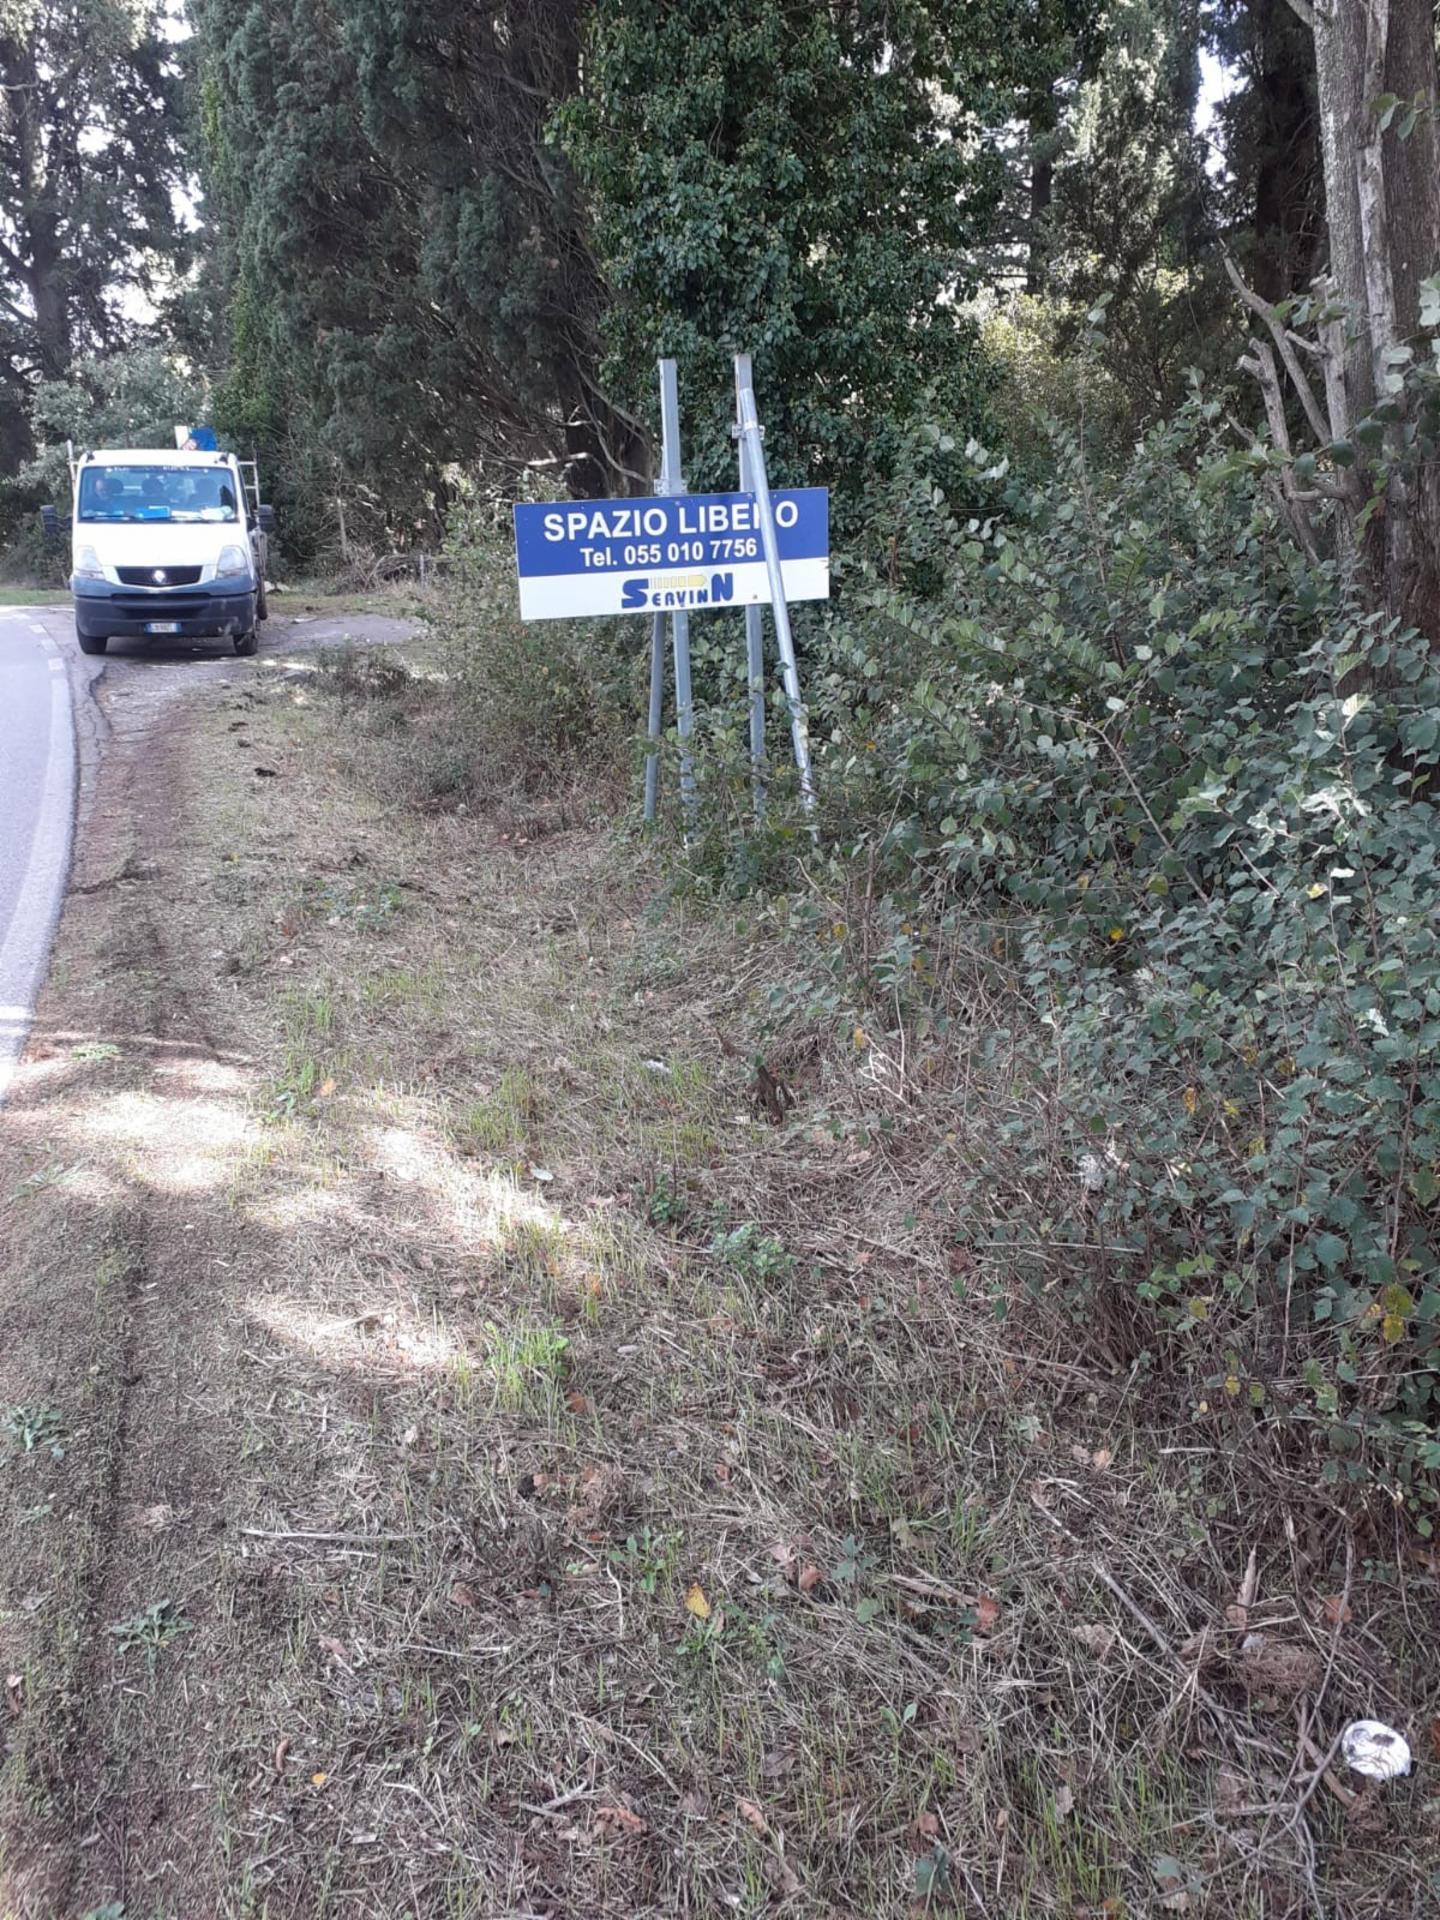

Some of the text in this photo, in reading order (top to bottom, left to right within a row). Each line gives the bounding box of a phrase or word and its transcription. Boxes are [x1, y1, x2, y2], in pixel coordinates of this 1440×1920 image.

[543, 508, 668, 541] SPAZIO
[580, 538, 757, 567] Tel. 055 010 7756
